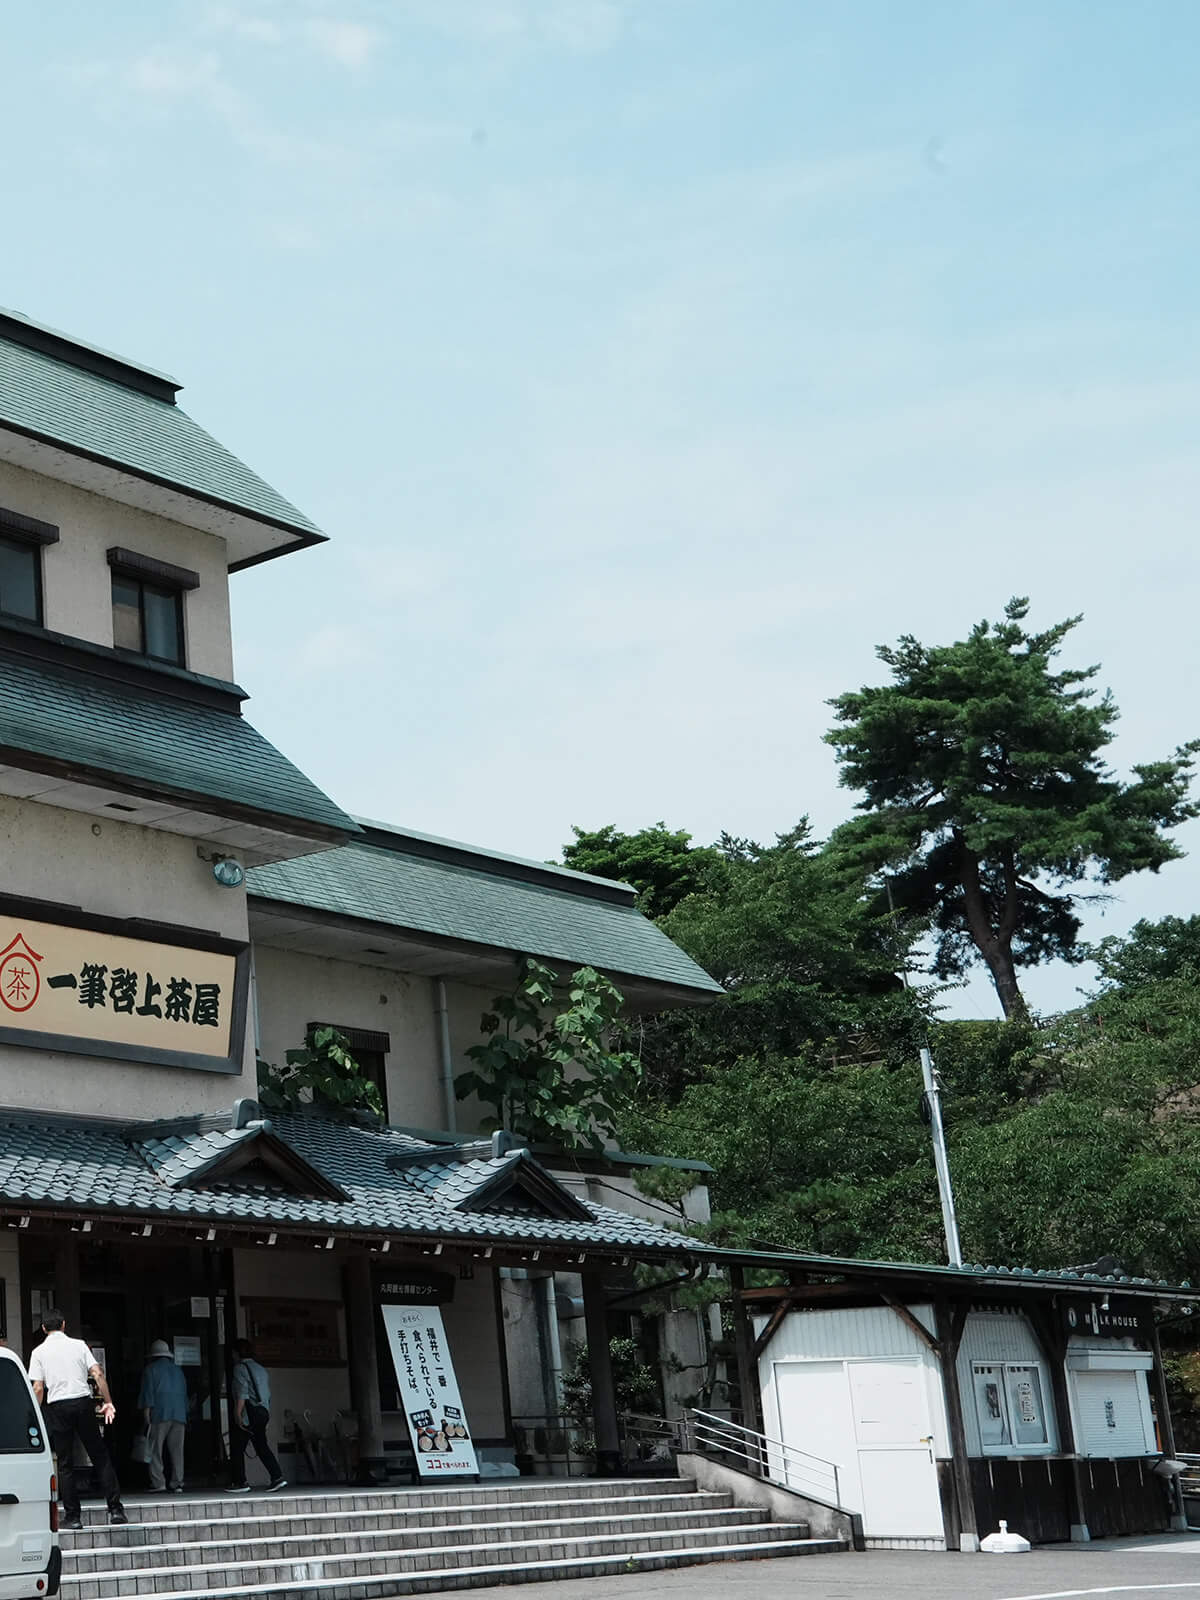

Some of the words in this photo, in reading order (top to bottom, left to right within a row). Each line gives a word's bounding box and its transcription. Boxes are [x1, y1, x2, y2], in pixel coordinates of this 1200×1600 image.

[6, 966, 31, 1001] 茶
[46, 961, 221, 1028] 一筆啓上茶屋
[1112, 1315, 1139, 1328] HOUSE
[412, 1329, 437, 1409] 食べられている
[426, 1328, 447, 1387] 福井で一番
